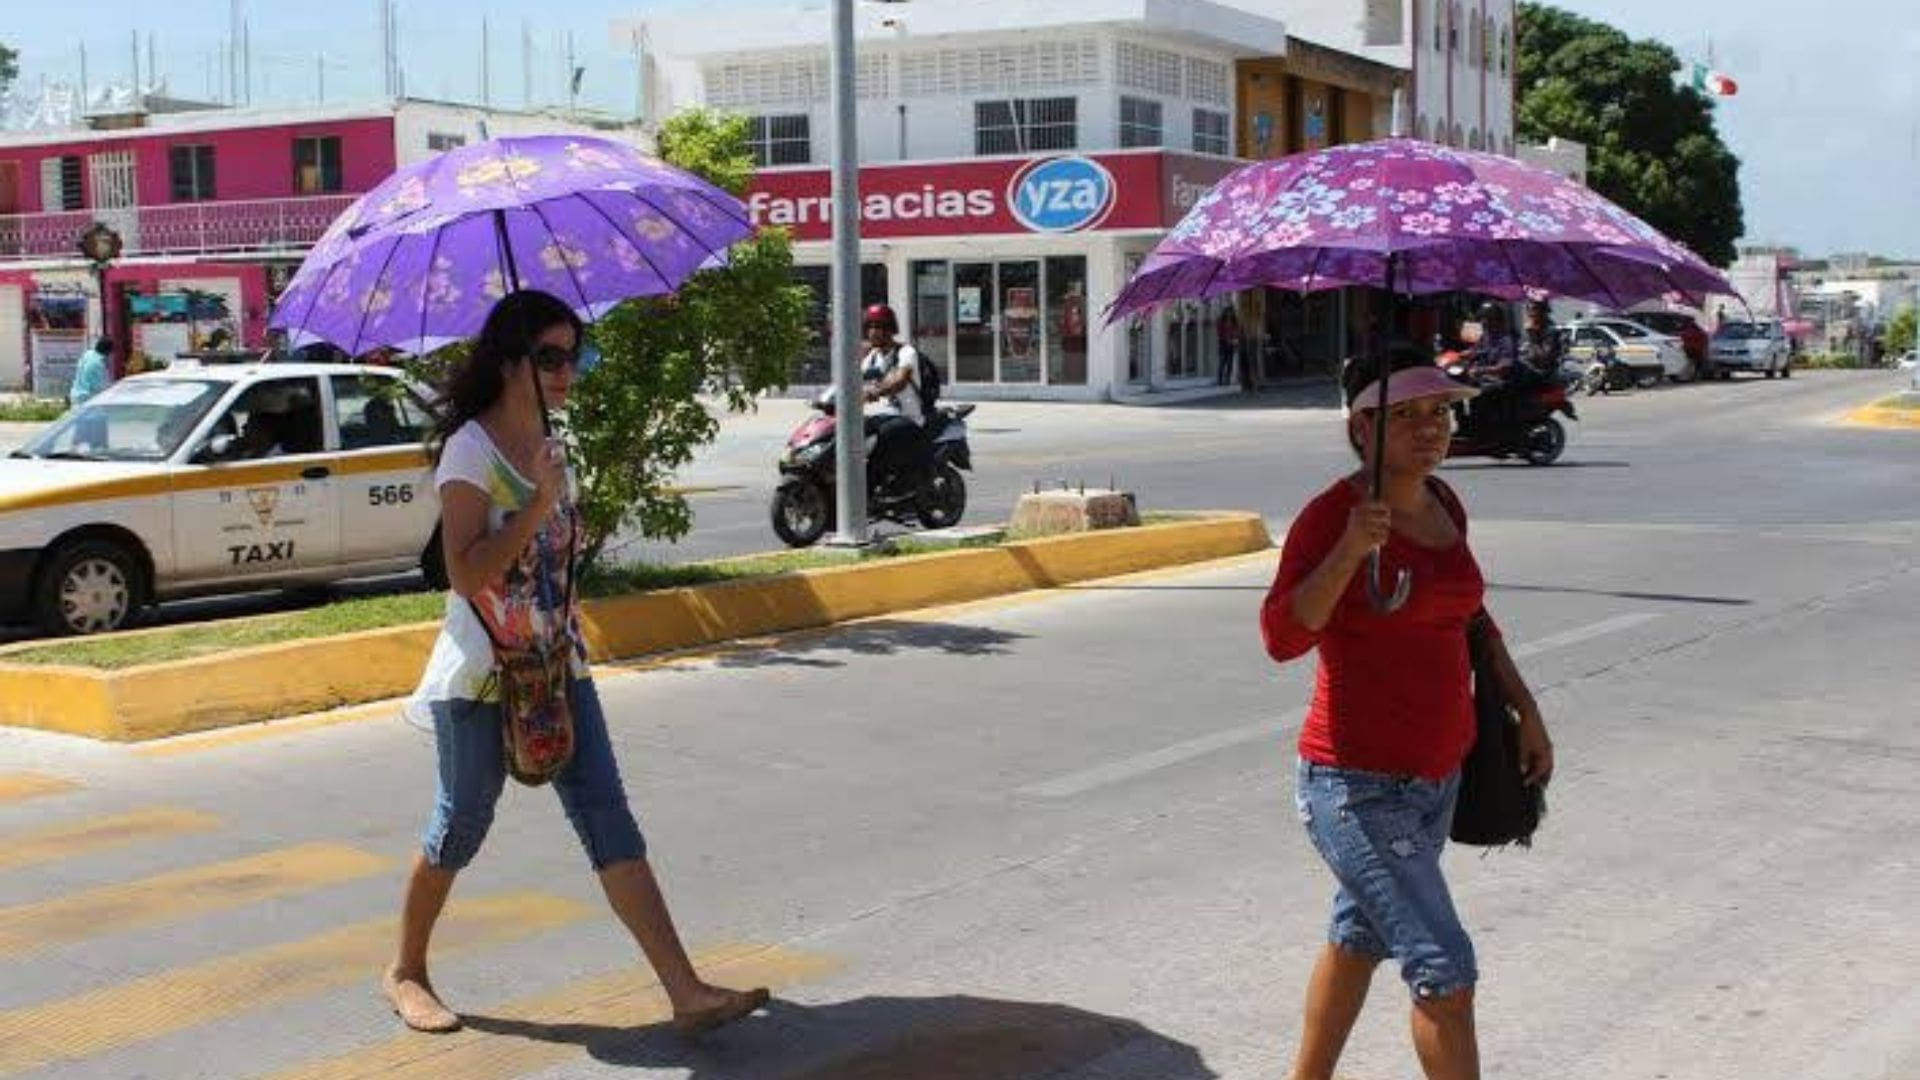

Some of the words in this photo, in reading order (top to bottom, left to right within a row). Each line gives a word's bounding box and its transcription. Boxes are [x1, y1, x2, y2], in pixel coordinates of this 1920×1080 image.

[1025, 178, 1097, 218] yza
[368, 483, 414, 506] 566
[227, 540, 294, 566] TAXI
